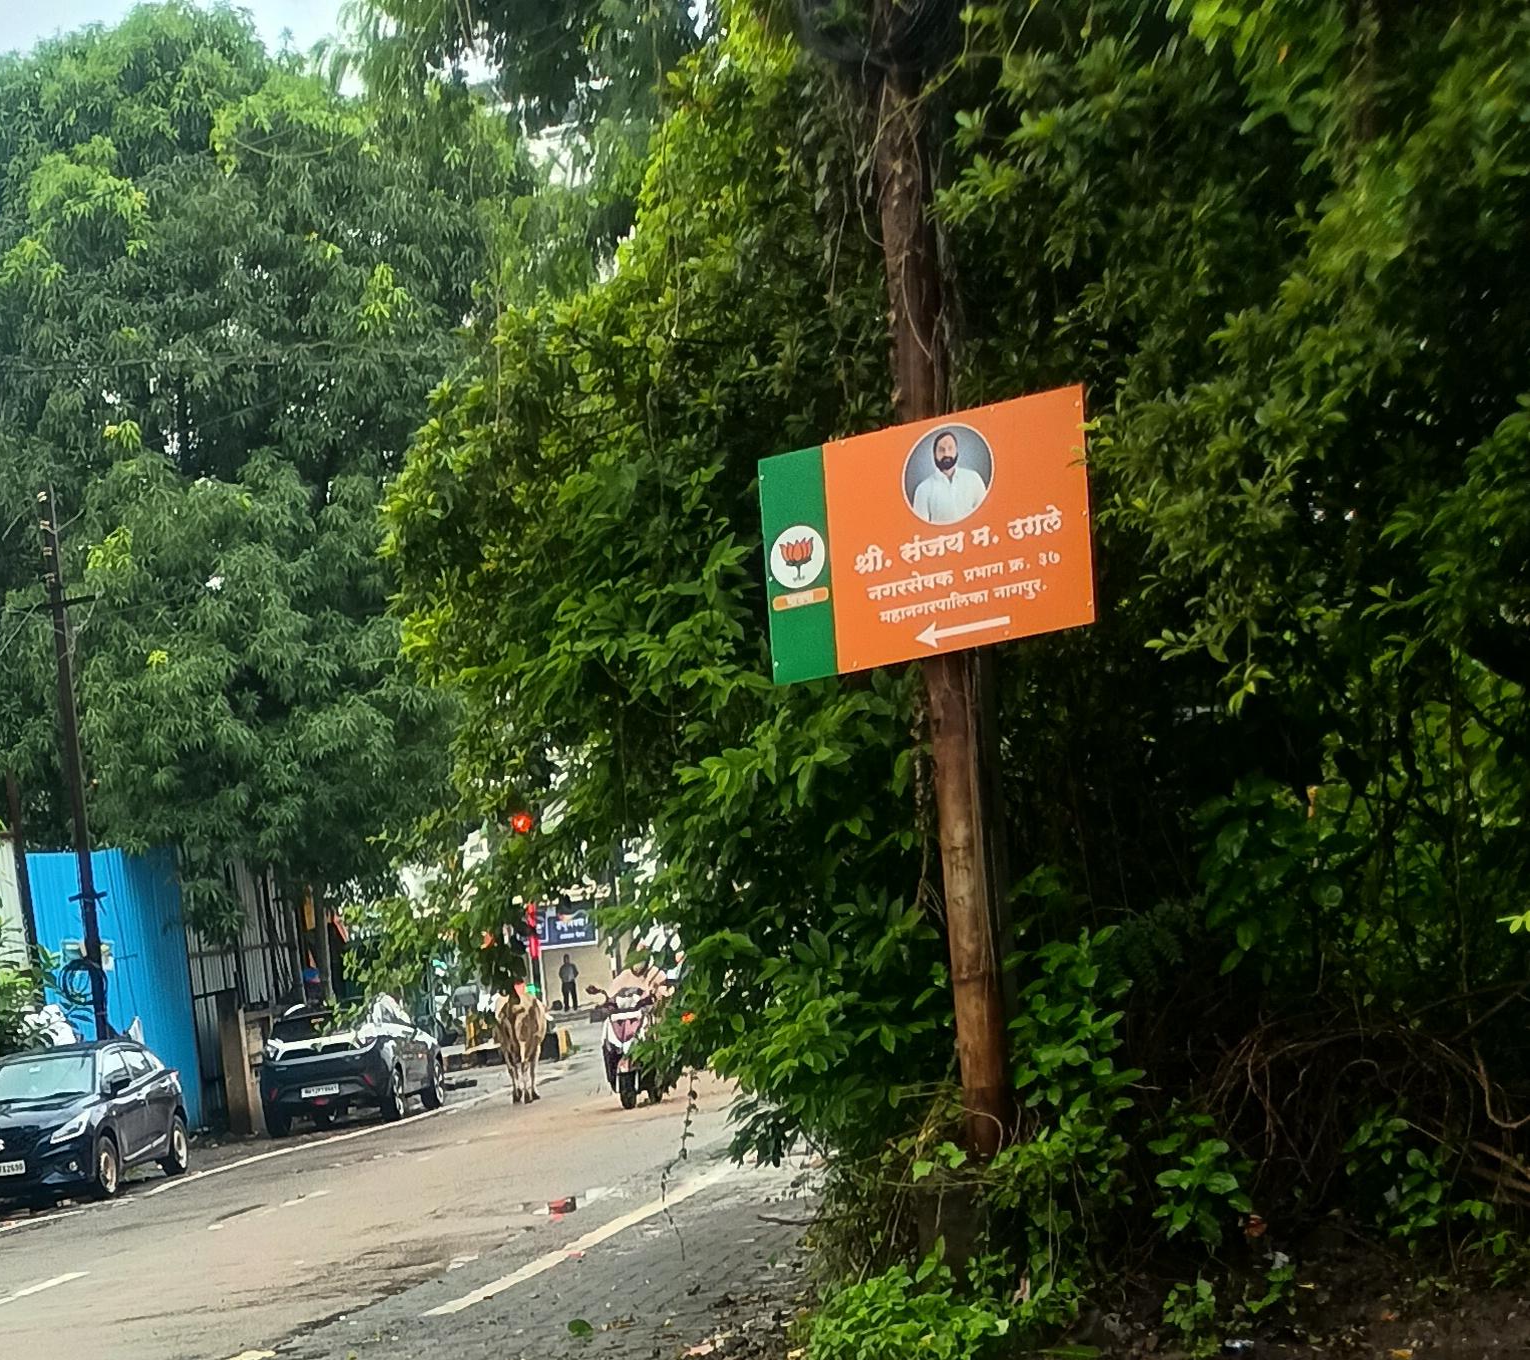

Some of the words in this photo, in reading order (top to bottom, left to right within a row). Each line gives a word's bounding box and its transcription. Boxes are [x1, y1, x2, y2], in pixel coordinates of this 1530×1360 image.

[854, 544, 892, 575] श्री.
[899, 534, 965, 564] संजय
[971, 526, 1000, 548] म.
[1007, 504, 1063, 540] उगले
[867, 571, 954, 601] नगरसेवक
[963, 562, 1004, 583] प्रभाग
[879, 591, 989, 624] महानगरपालिका
